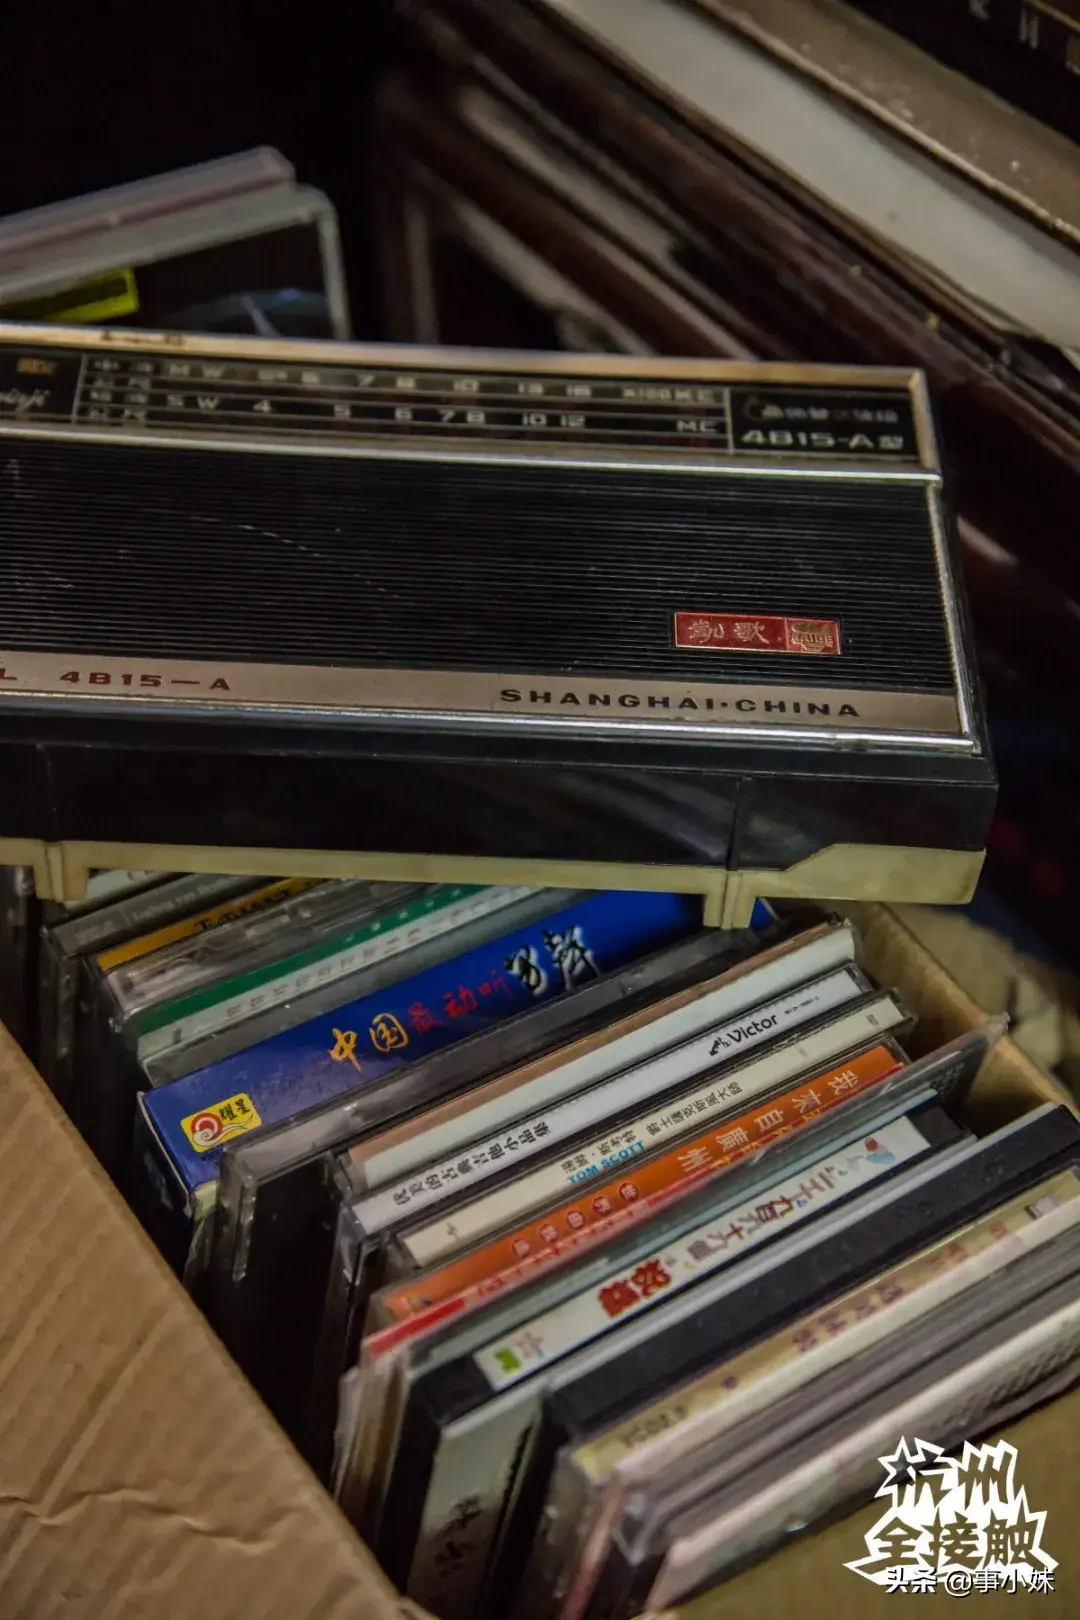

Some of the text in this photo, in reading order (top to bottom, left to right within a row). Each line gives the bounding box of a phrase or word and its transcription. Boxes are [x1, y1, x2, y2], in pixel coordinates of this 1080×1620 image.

[253, 399, 272, 413] 4
[333, 404, 352, 419] 5
[395, 407, 413, 421] 6
[522, 413, 548, 427] 10
[560, 414, 586, 428] 12
[726, 1014, 780, 1044] Victor
[567, 1139, 647, 1186] TOM SCOTT
